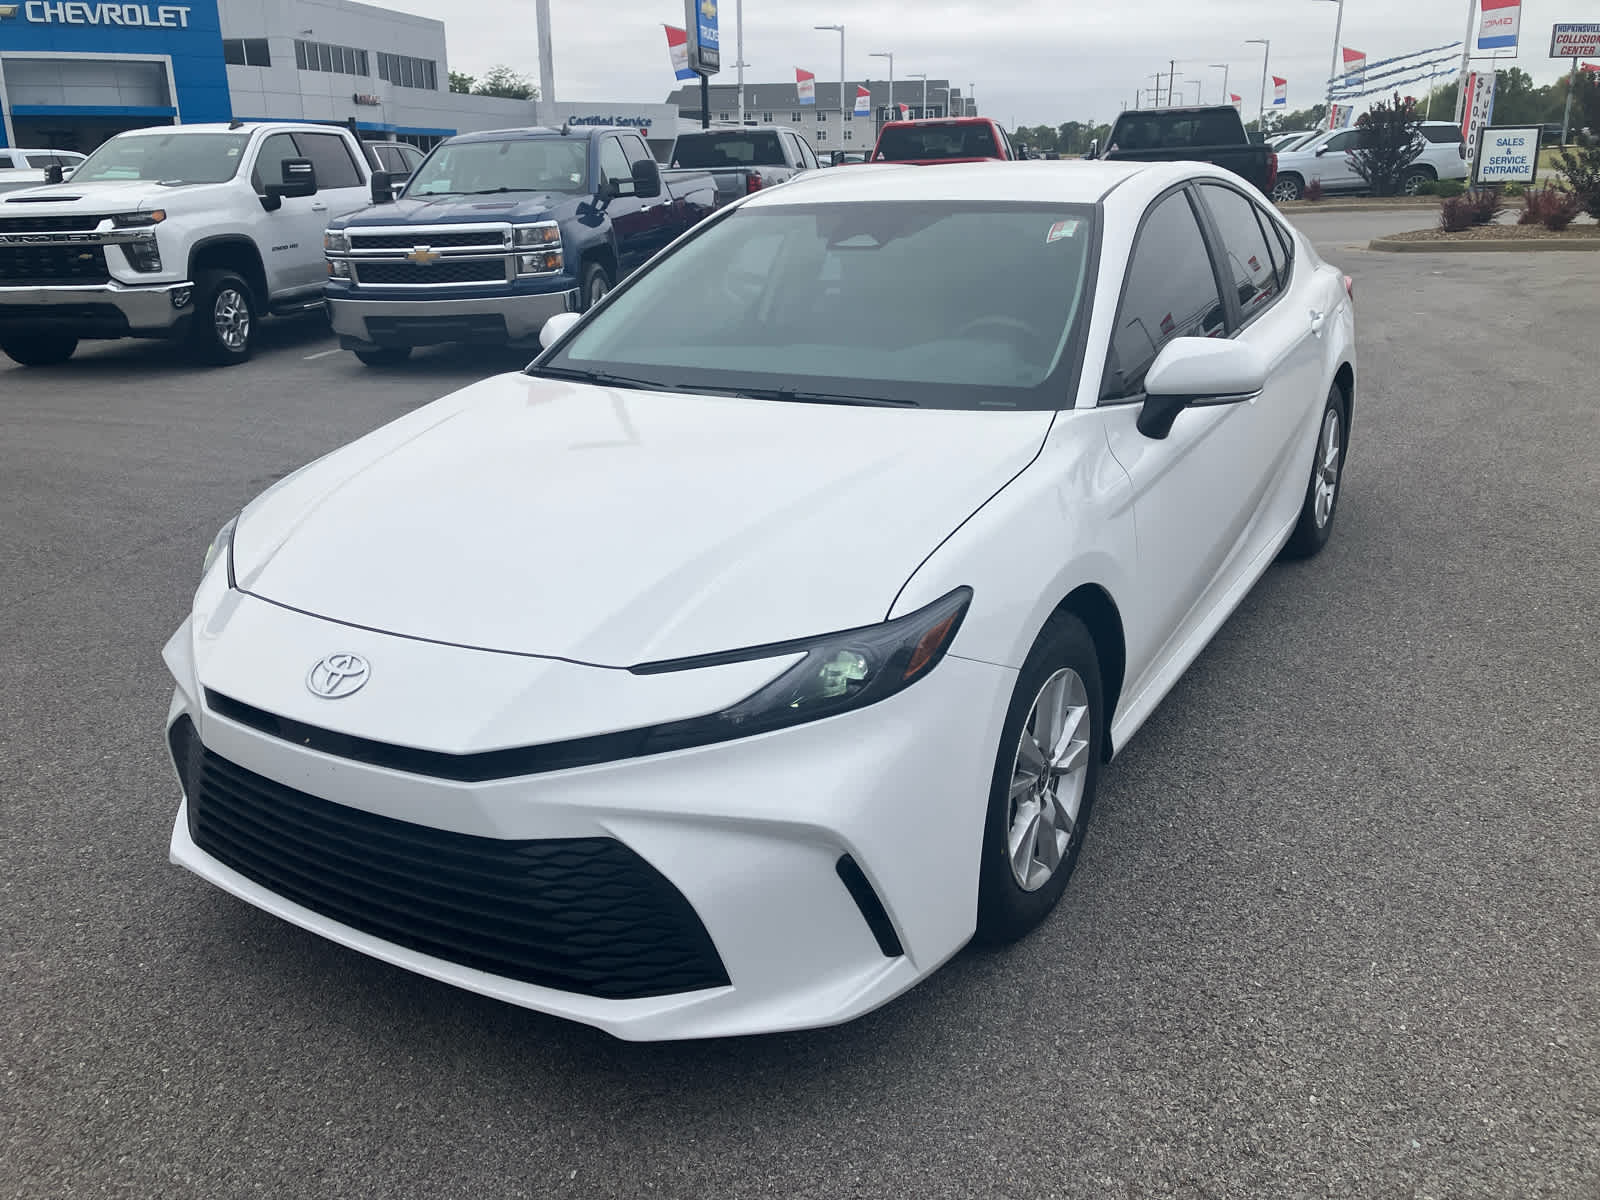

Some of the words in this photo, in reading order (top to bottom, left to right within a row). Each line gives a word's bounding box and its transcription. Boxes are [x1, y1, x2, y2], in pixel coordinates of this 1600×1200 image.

[25, 1, 191, 28] CHEVROLET
[1560, 45, 1596, 55] CENTER
[568, 115, 614, 126] Certified
[616, 115, 652, 127] Service
[1496, 137, 1526, 147] SALES
[1506, 147, 1512, 155] &
[1489, 156, 1527, 165] SERVICE
[1483, 165, 1530, 175] ENTRANCE
